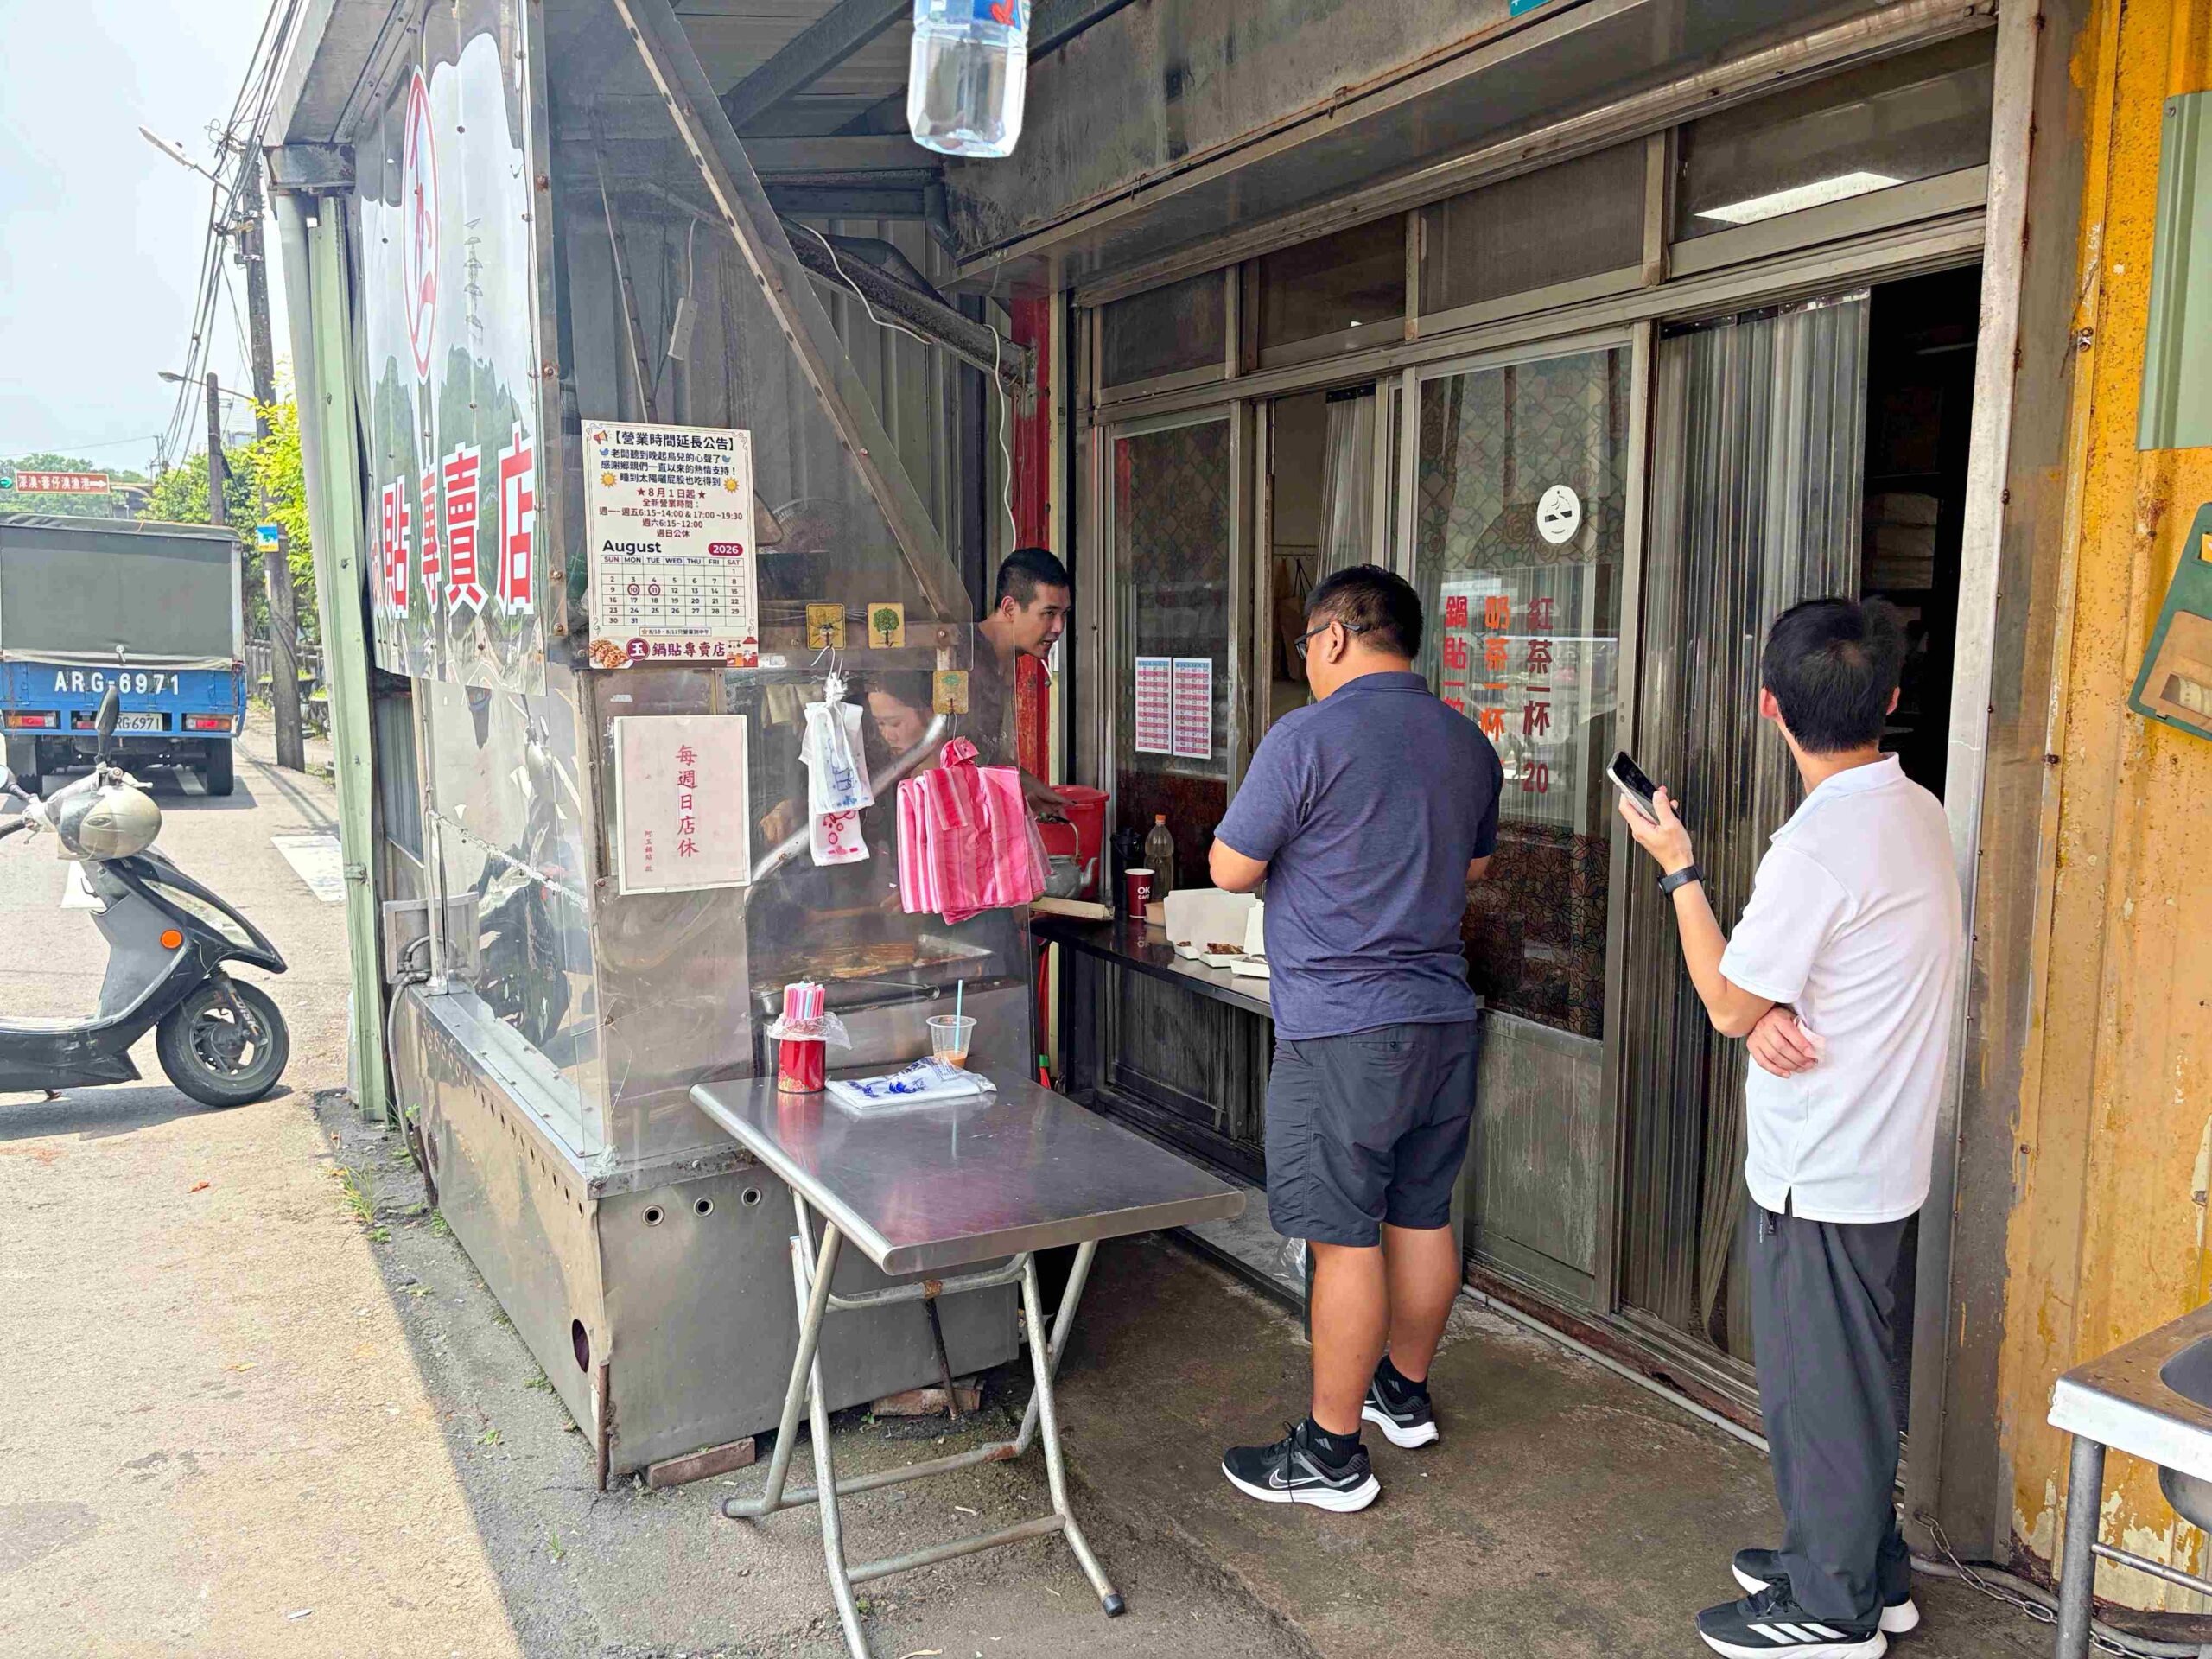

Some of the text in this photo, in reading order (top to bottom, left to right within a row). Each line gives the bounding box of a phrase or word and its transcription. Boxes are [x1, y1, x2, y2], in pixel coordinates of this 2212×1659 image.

[614, 431, 734, 451] 【營業時間延長公告】
[371, 431, 533, 611] 貼專賣店
[657, 529, 690, 537] 週日公休
[603, 540, 738, 555] August 2026
[652, 643, 725, 658] 鍋貼專賣店
[1480, 595, 1510, 741] 奶茶一杯
[54, 671, 178, 695] ARG-6971
[1523, 597, 1554, 793] 紅茶一杯 20
[116, 716, 159, 730] RG-6971
[676, 744, 699, 857] 每週日店休
